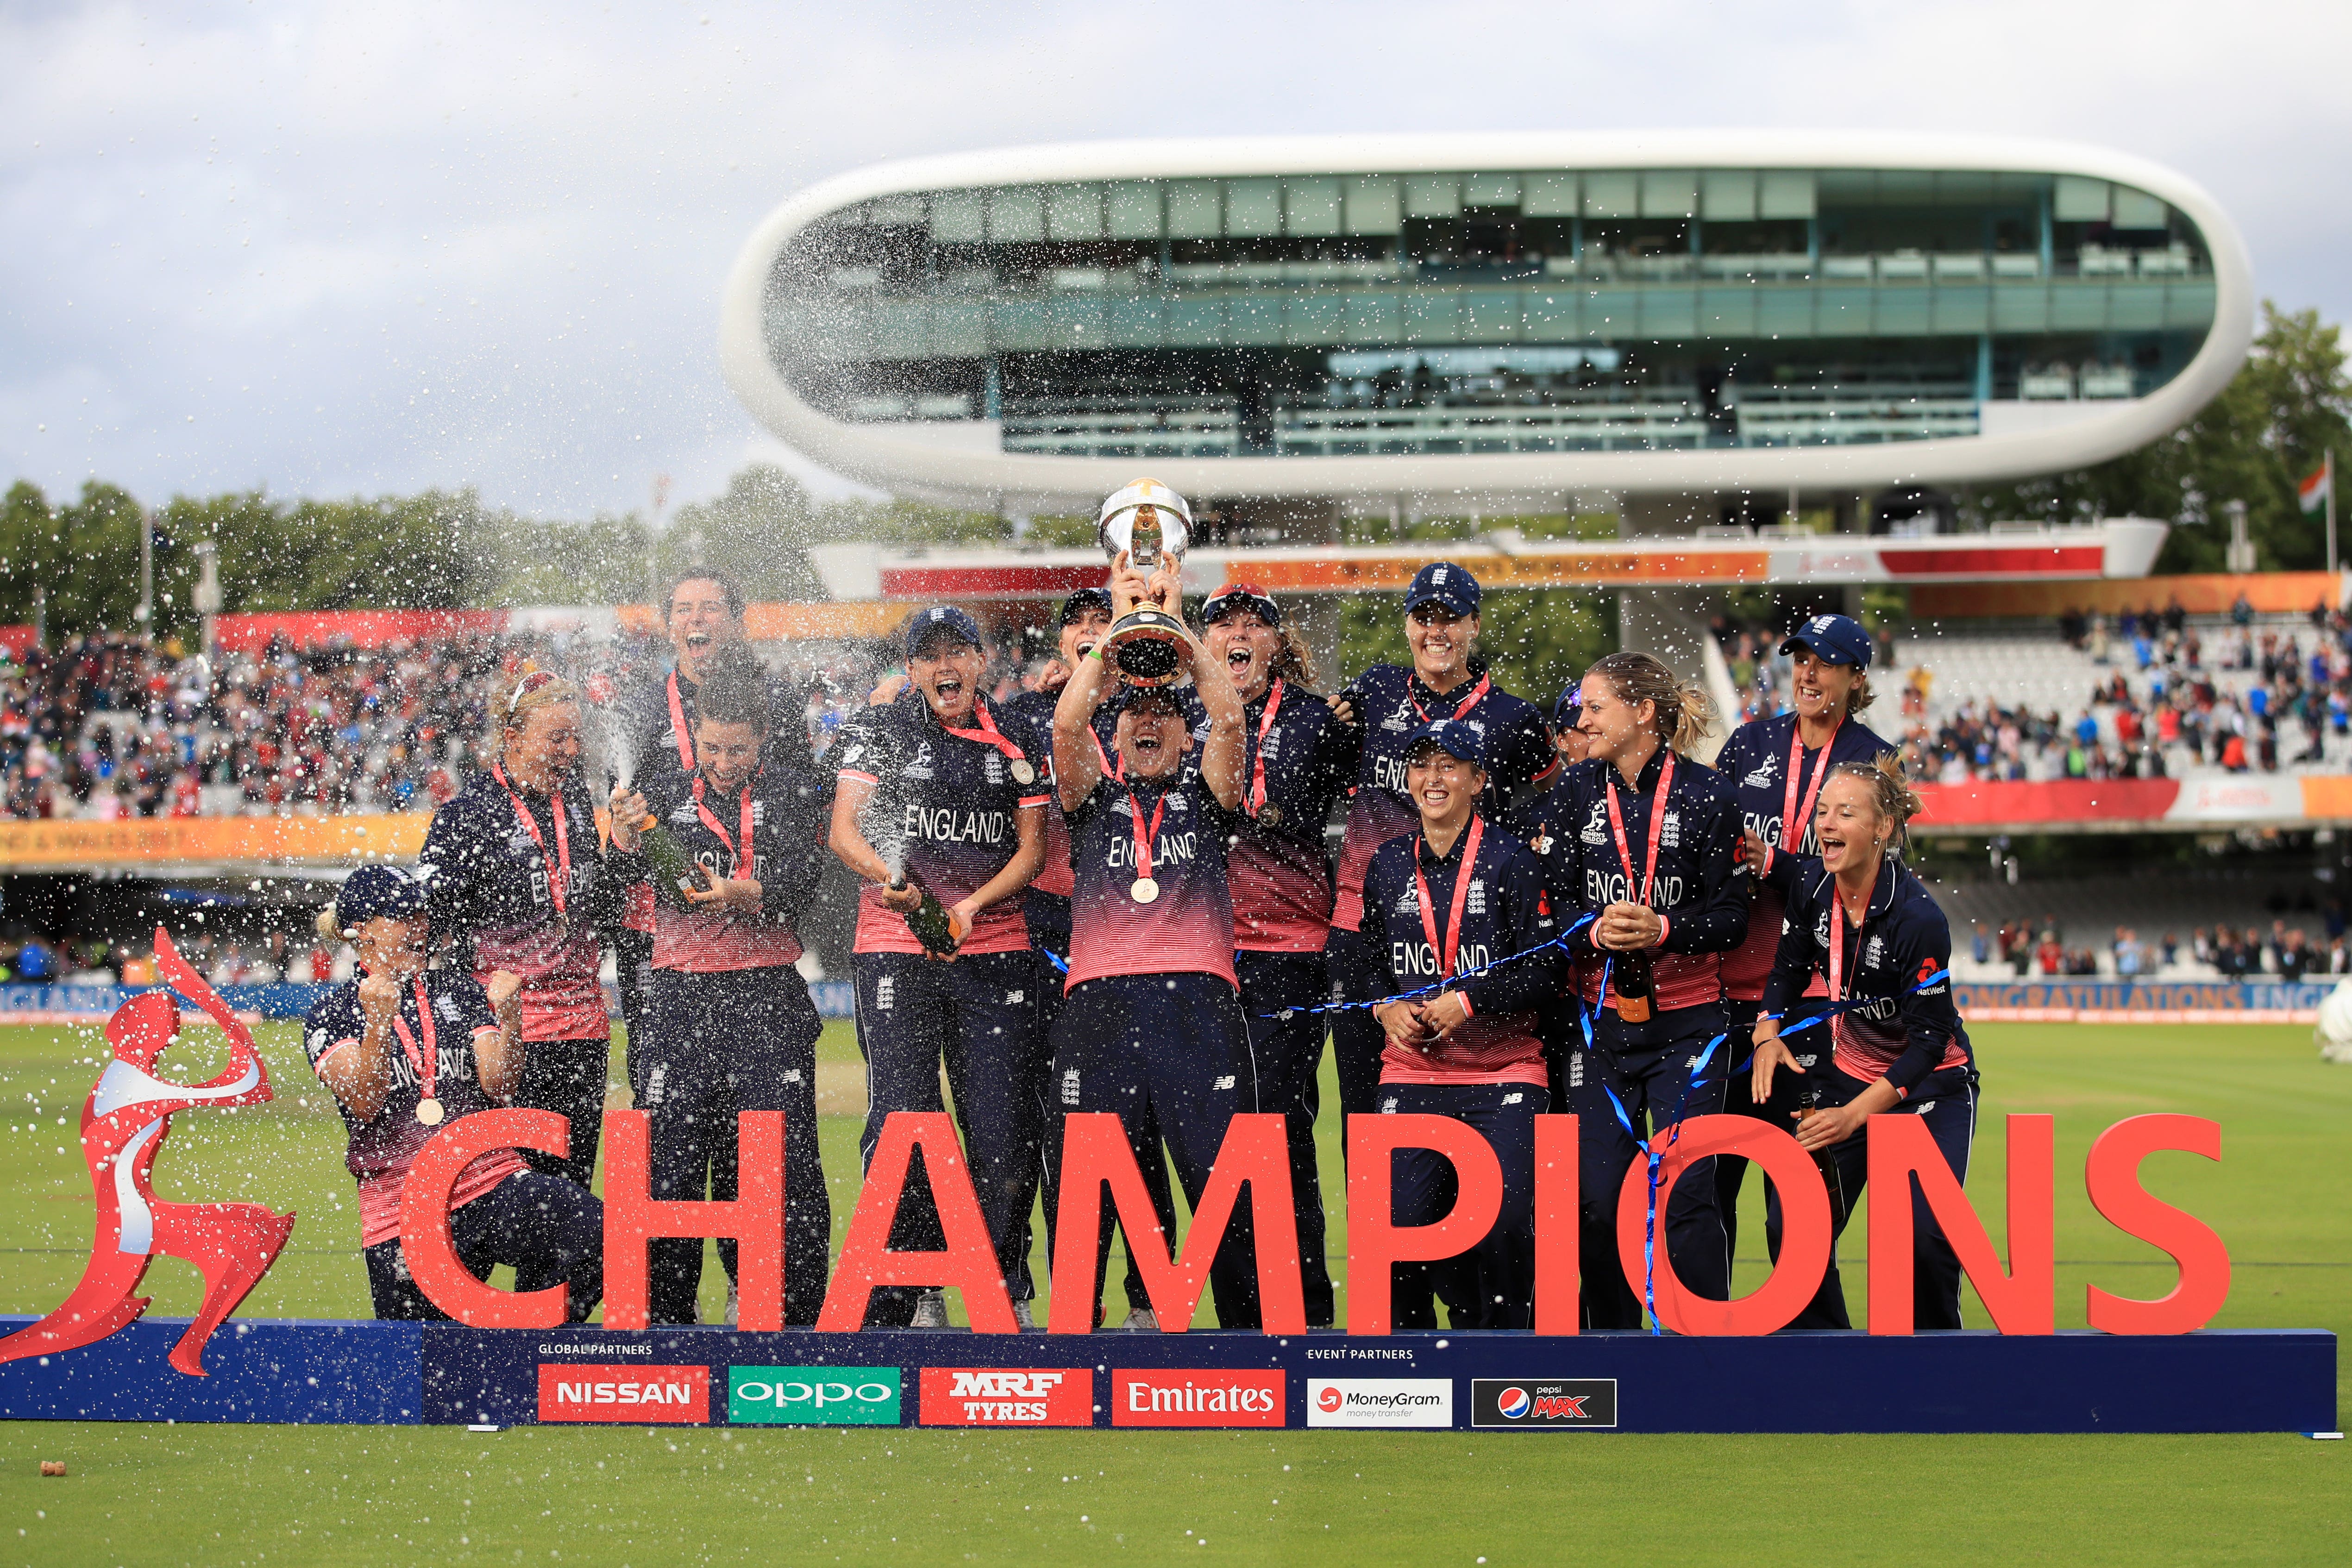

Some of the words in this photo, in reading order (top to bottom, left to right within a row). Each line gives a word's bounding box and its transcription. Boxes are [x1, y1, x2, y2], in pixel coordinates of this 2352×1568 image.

[1748, 773, 1770, 783] WOMEN'S
[905, 805, 1003, 843] ENGLAND
[1917, 985, 1945, 996] NatWest
[1954, 985, 2245, 1009] ONGRATULATIONS
[399, 1108, 2231, 1336] CHAMPIONS
[539, 1344, 587, 1355] GLOBAL
[590, 1345, 652, 1355] PARTNERS
[1308, 1349, 1346, 1359] EVENT
[1349, 1349, 1413, 1360] PARTNERS
[558, 1382, 690, 1404] NISSAN
[949, 1373, 1062, 1397] MRF
[1536, 1385, 1562, 1395] pepsi
[1128, 1381, 1274, 1412] Emirates
[1346, 1392, 1440, 1409] MoneyGram
[964, 1402, 1047, 1421] TYRES
[1378, 1409, 1413, 1417] transfer
[1531, 1396, 1591, 1419] MAX
